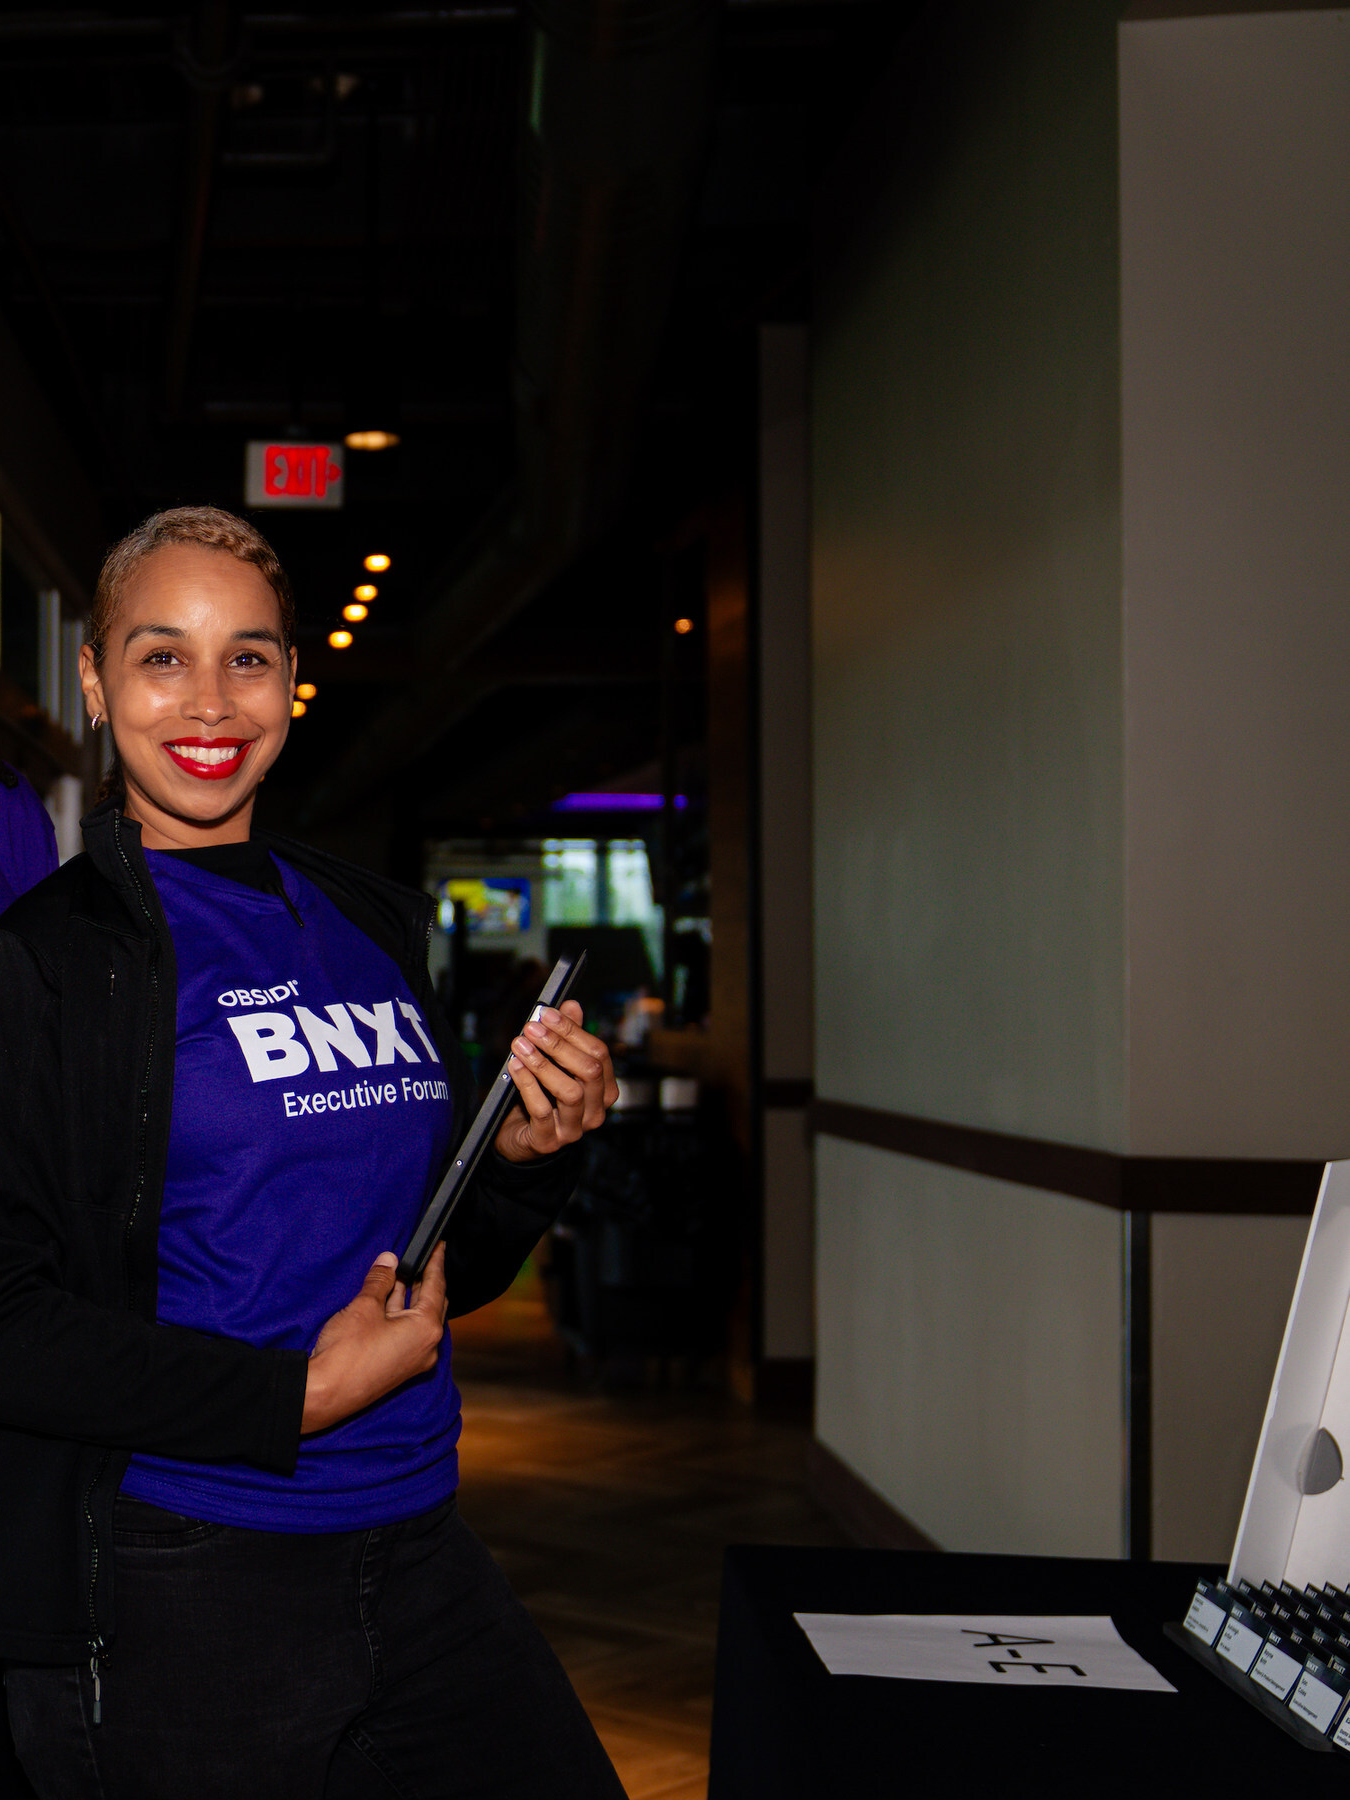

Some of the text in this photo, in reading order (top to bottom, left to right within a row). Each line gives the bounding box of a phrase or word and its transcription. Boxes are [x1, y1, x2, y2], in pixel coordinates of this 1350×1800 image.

[227, 997, 440, 1083] BNXT
[282, 1077, 449, 1118] Executive Forum
[960, 1629, 1088, 1677] A-E
